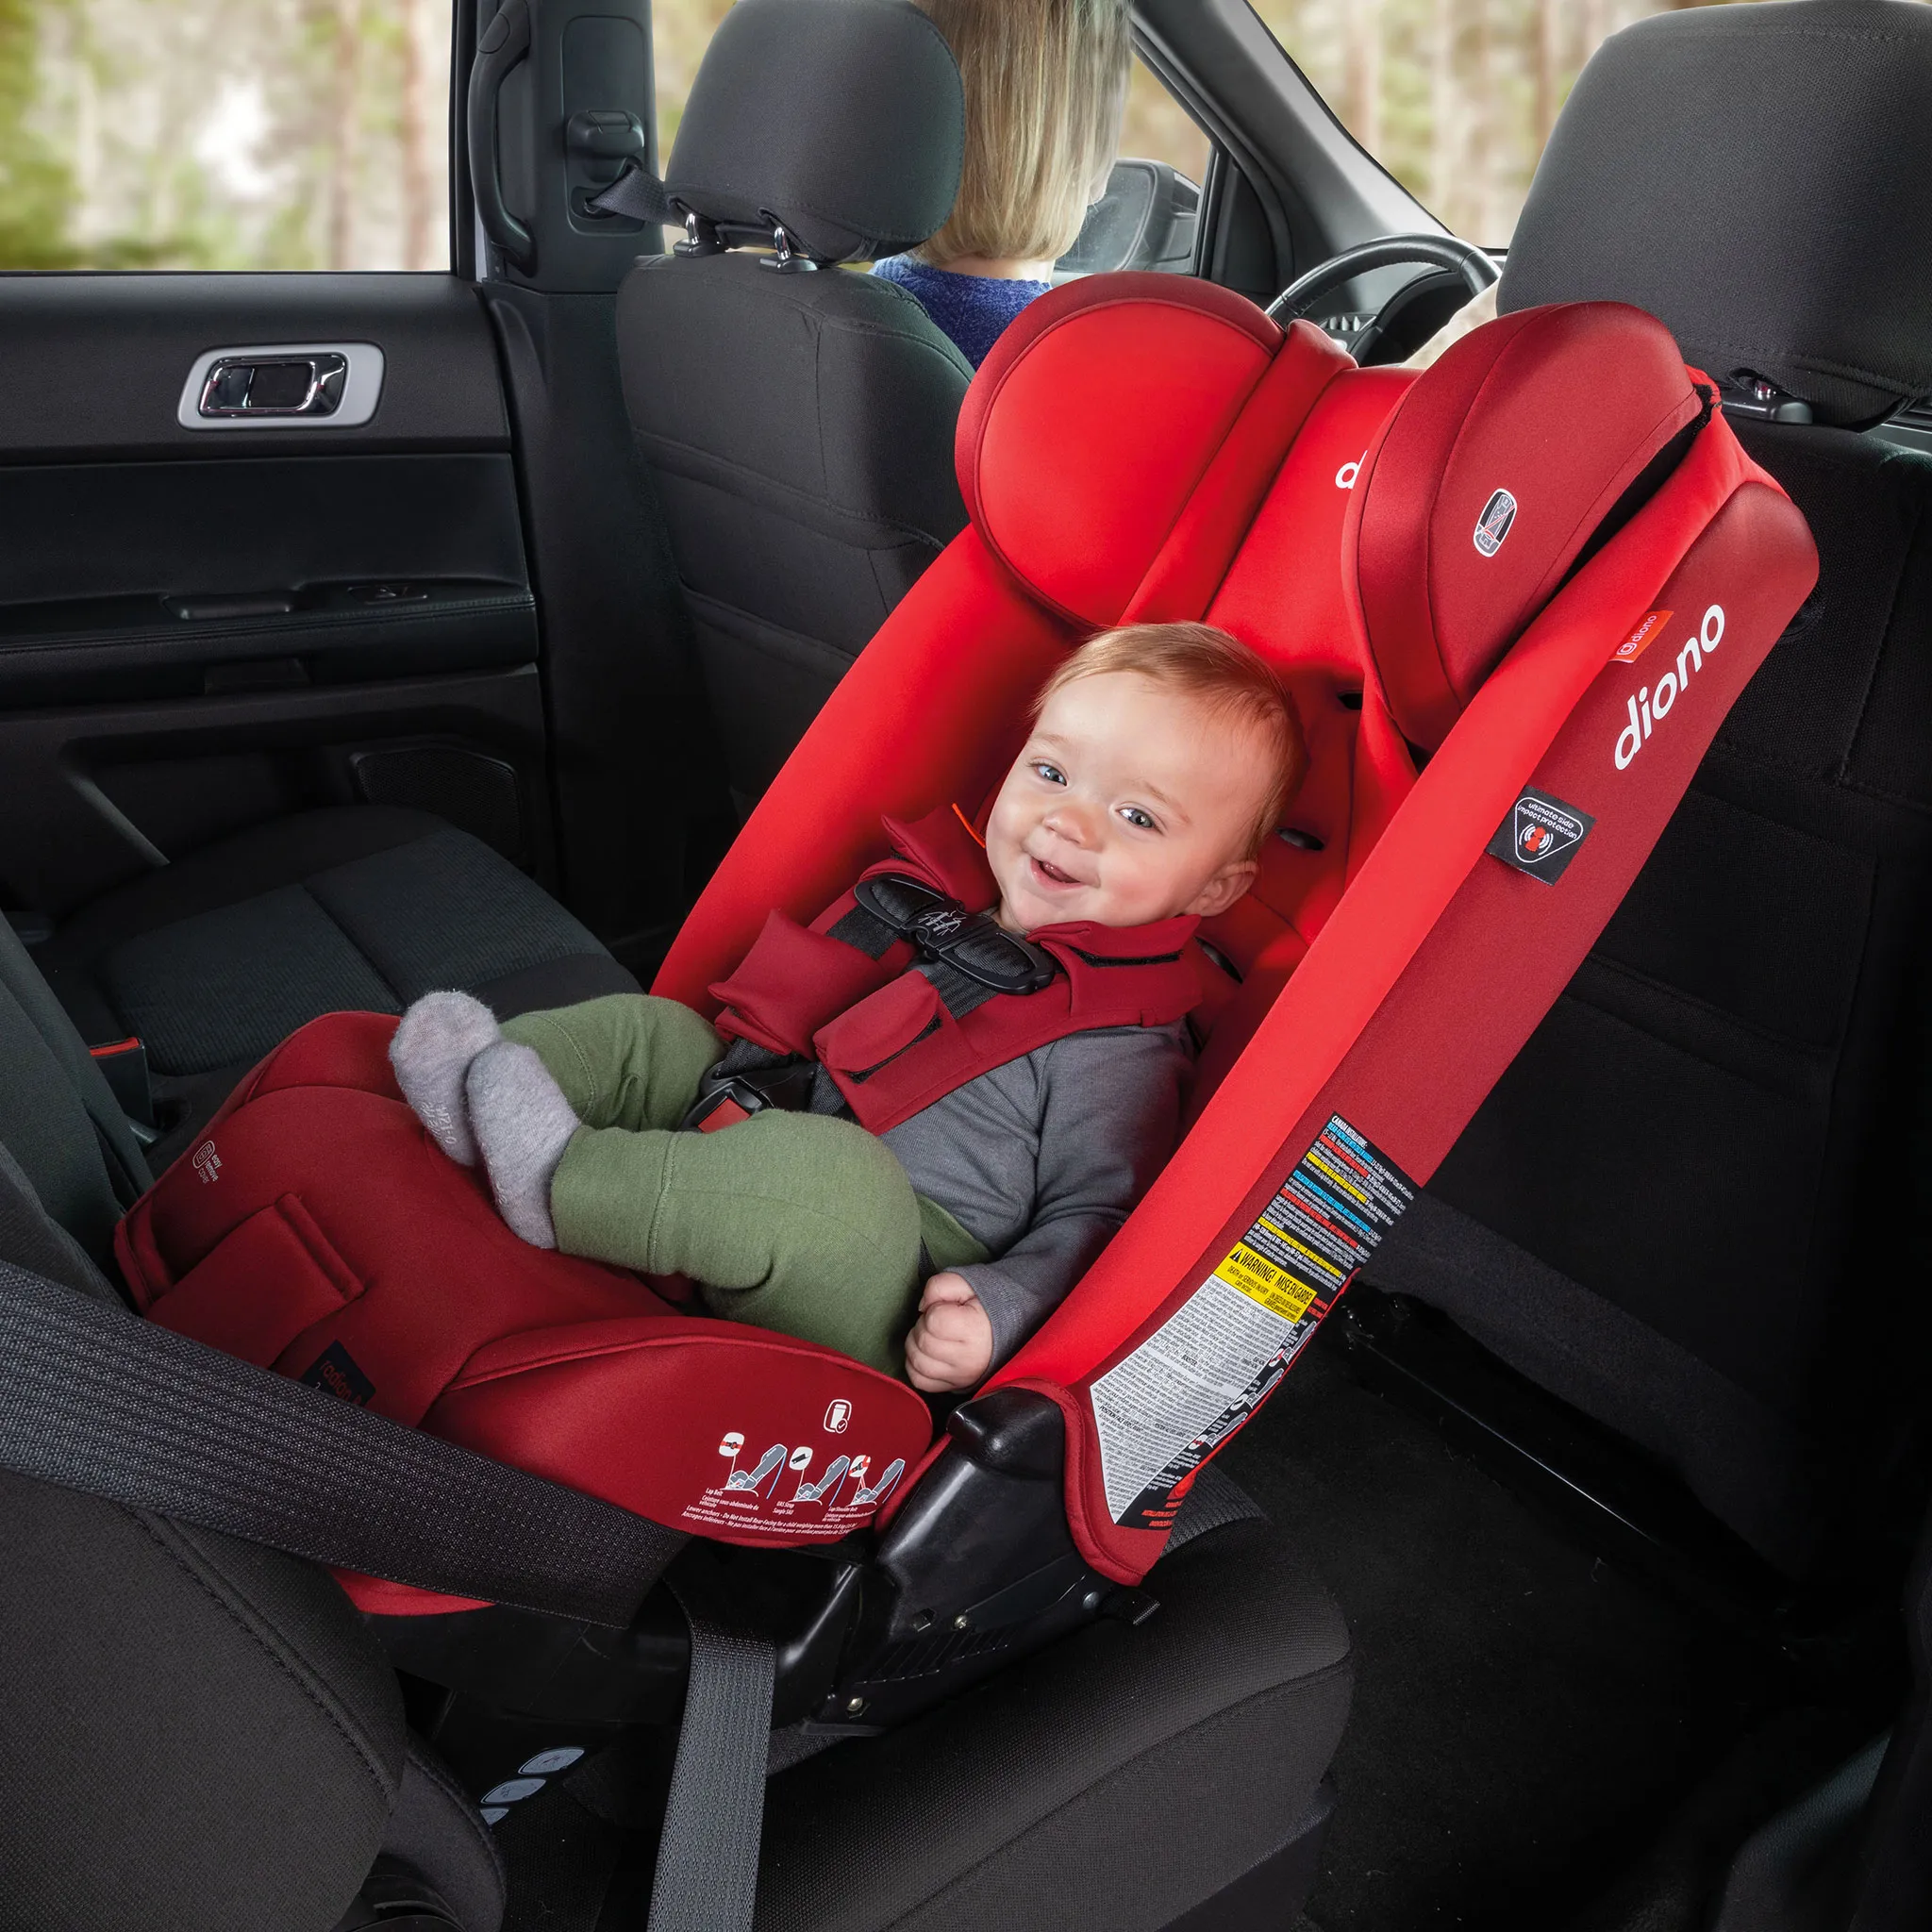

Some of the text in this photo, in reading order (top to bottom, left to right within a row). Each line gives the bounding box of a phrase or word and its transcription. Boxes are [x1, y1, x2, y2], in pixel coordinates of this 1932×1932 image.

[1631, 615, 1657, 641] diono
[1614, 605, 1726, 771] diono
[1517, 805, 1577, 840] impact protection
[1528, 803, 1574, 829] ultimate side
[205, 1160, 218, 1182] remove
[211, 1154, 223, 1169] easy
[1227, 1265, 1241, 1276] DEATH
[1239, 1251, 1277, 1284] WARNING!
[1274, 1275, 1291, 1292] MISE
[1288, 1283, 1299, 1296] EN
[681, 1510, 704, 1521] Ancrages
[686, 1505, 701, 1513] Lower
[701, 1507, 720, 1517] anchors
